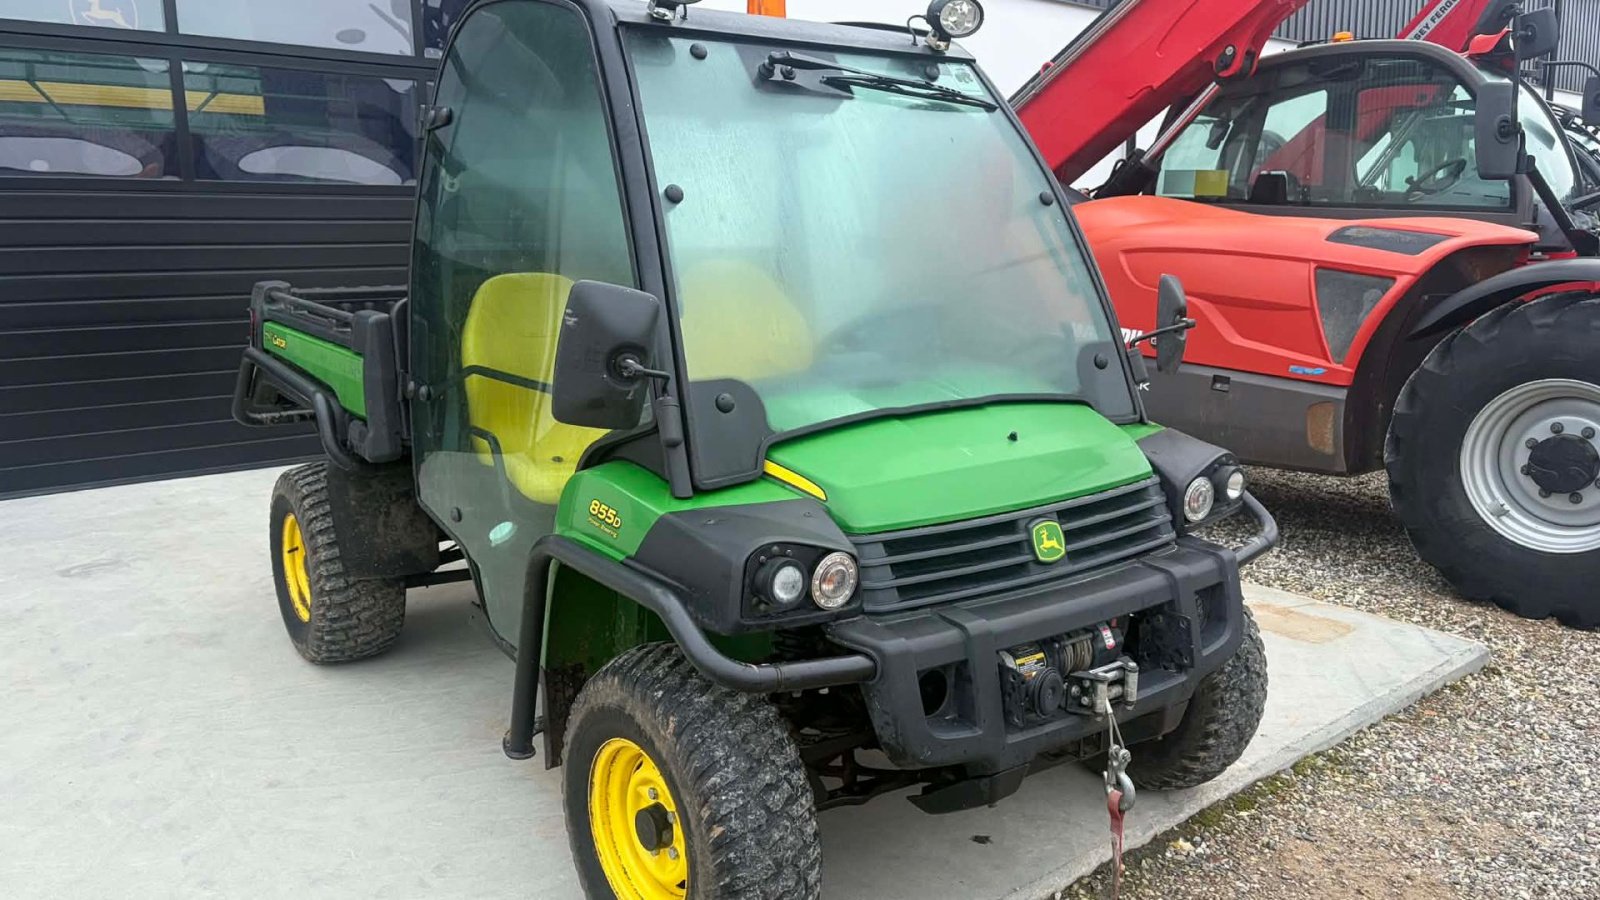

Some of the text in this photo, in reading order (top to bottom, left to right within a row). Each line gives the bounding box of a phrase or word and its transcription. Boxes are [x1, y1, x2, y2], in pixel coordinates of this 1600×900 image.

[1412, 0, 1458, 40] SEY FERG
[589, 499, 621, 528] 855D
